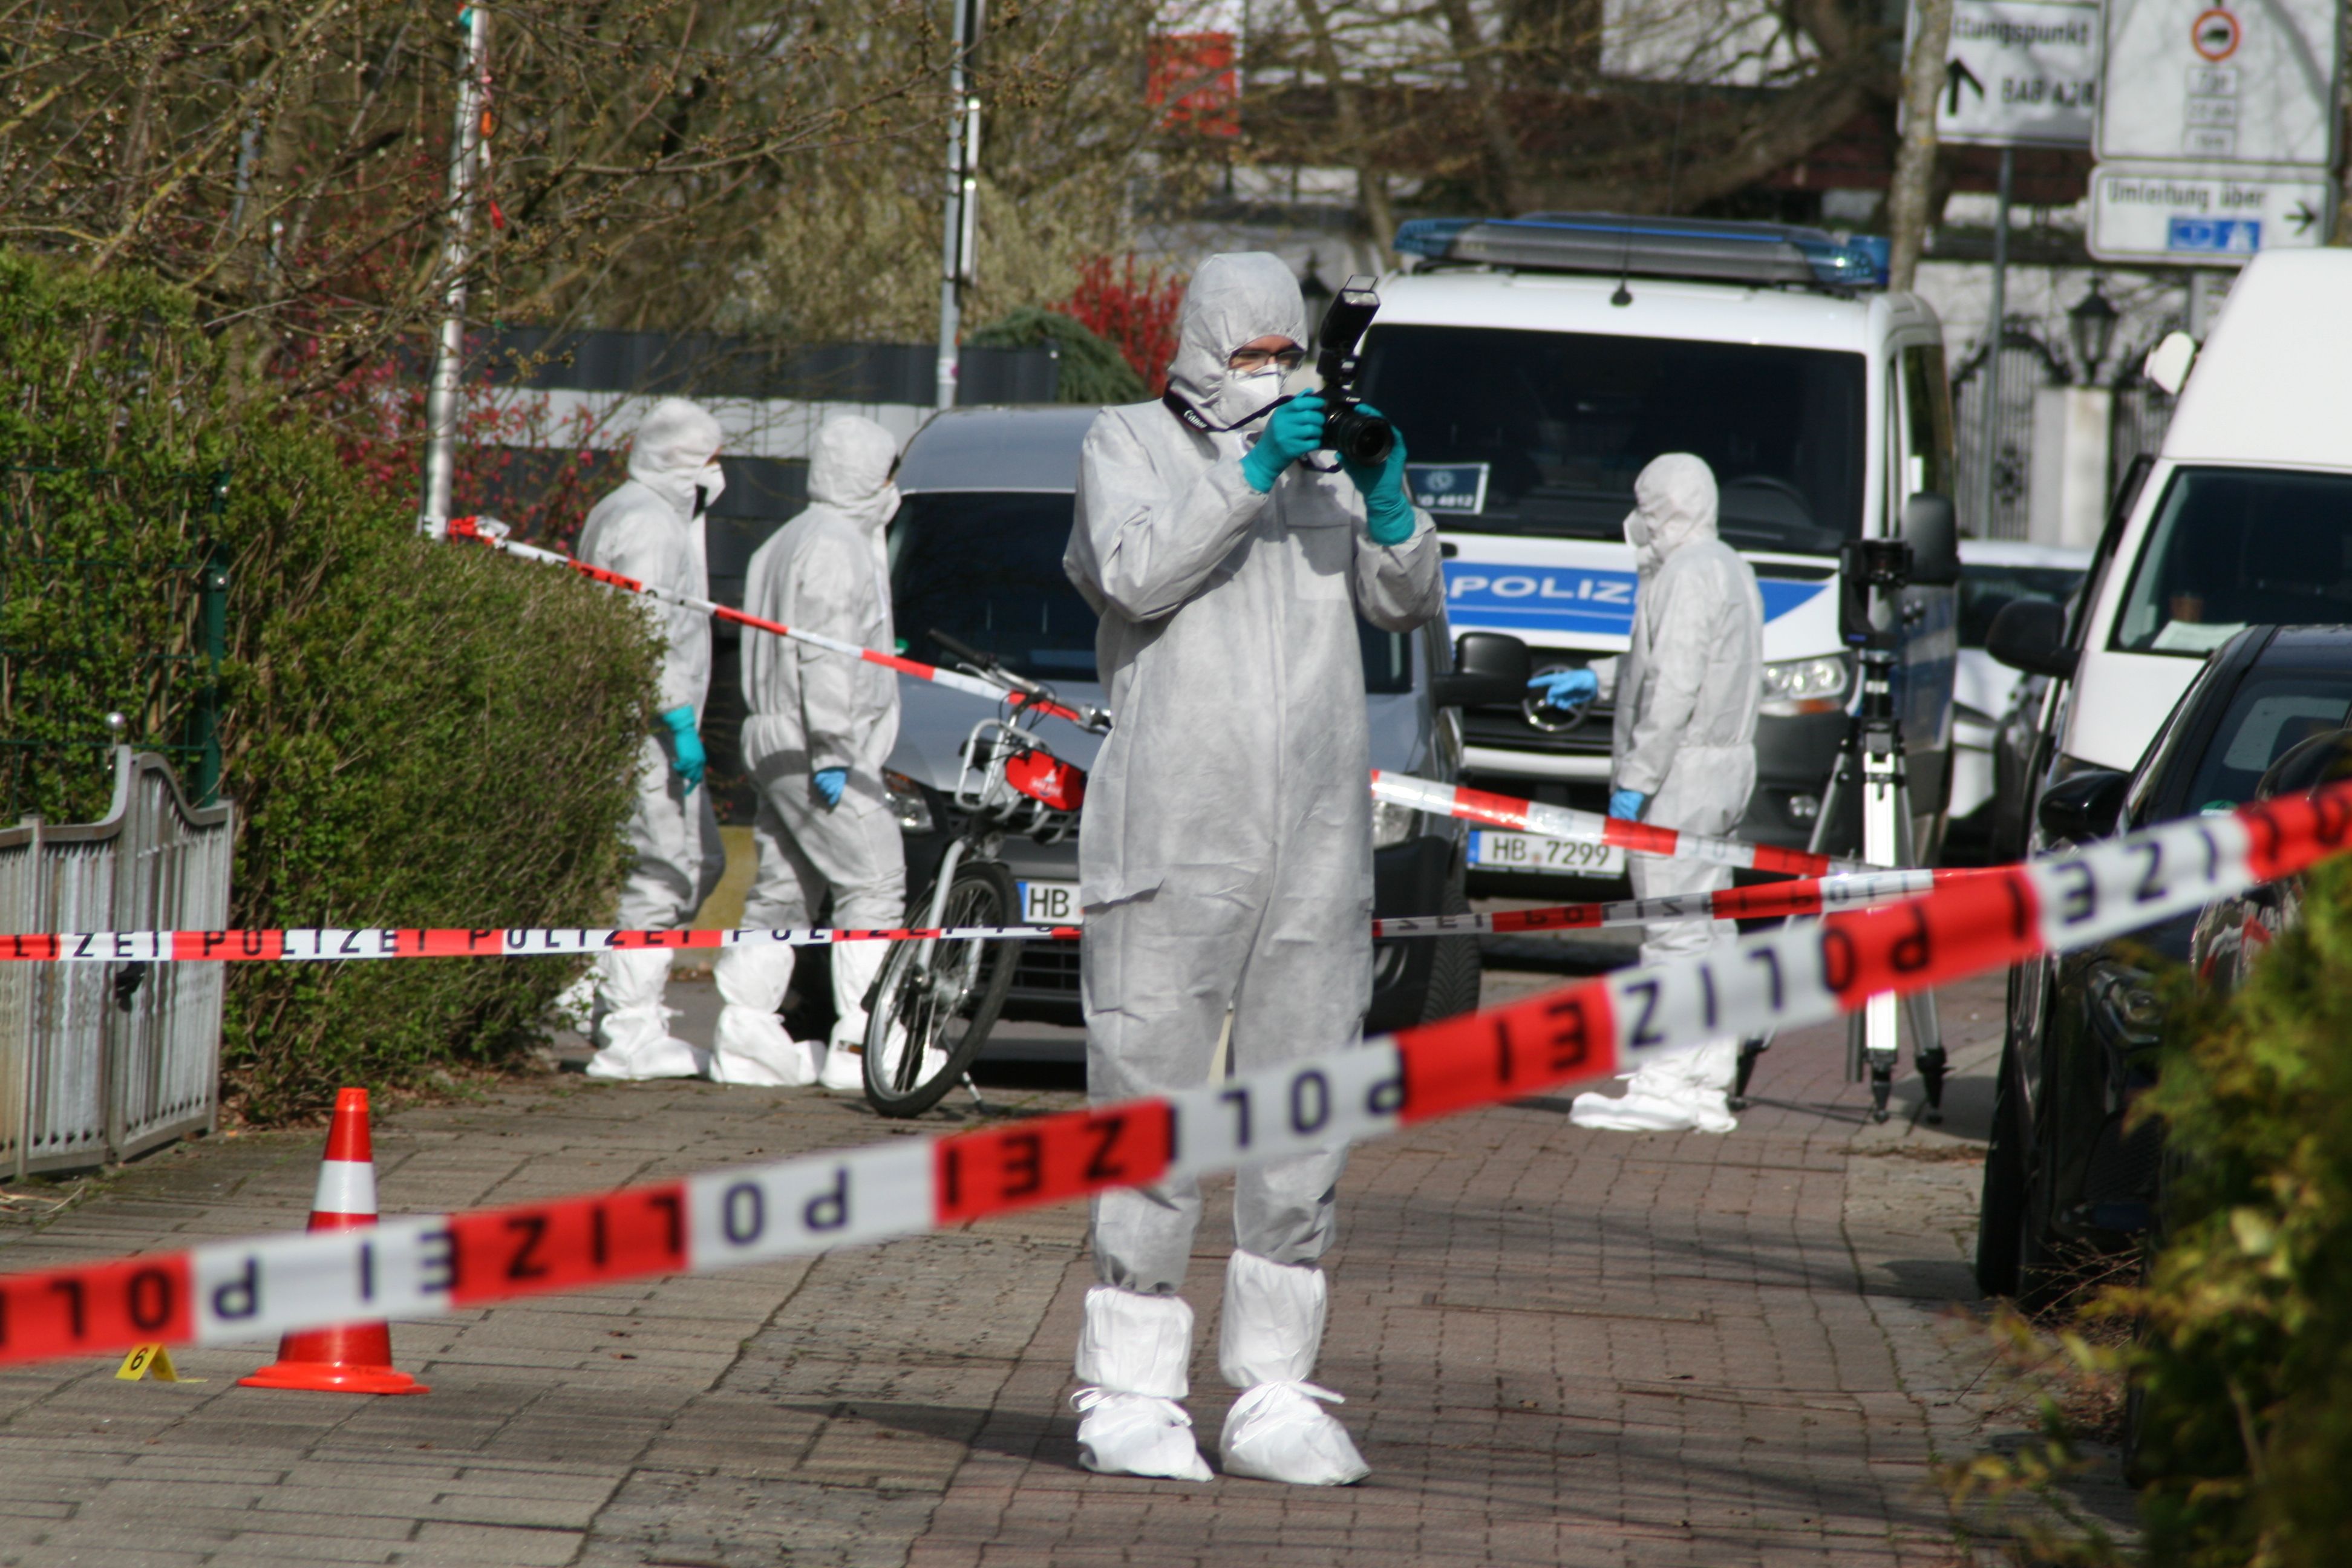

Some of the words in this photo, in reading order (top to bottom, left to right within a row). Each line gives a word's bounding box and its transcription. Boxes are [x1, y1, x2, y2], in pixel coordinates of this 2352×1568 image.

[2108, 180, 2209, 213] Umleitung
[2220, 181, 2264, 206] über
[1449, 576, 1633, 604] POLIZ
[1492, 837, 1527, 862] HB
[1546, 840, 1610, 866] 7299
[2007, 795, 2351, 939] OLIZEI
[1029, 887, 1070, 918] HB
[13, 930, 160, 958] LIZEI
[203, 929, 426, 956] POLIZEI
[1494, 910, 1930, 1082] POLIZEI
[944, 1046, 1406, 1206] POLIZEI
[358, 1168, 849, 1302] POLIZEI
[130, 1347, 149, 1371] 6
